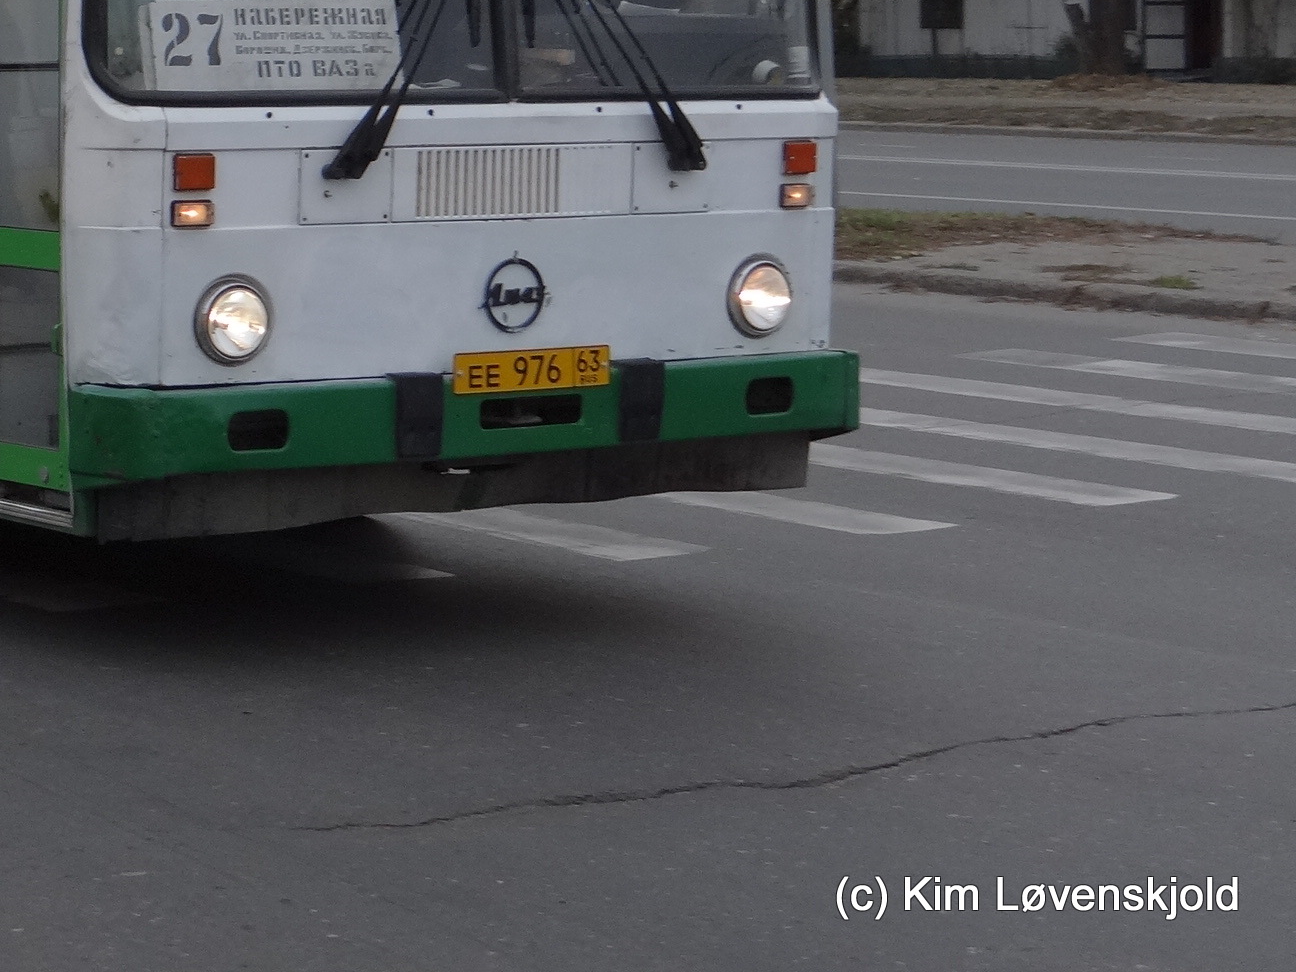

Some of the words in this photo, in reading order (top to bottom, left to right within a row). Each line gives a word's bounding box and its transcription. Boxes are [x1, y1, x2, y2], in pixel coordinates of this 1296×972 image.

[161, 12, 223, 67] 27
[256, 60, 302, 78] ПТО
[514, 354, 561, 385] 976
[577, 350, 600, 372] 63
